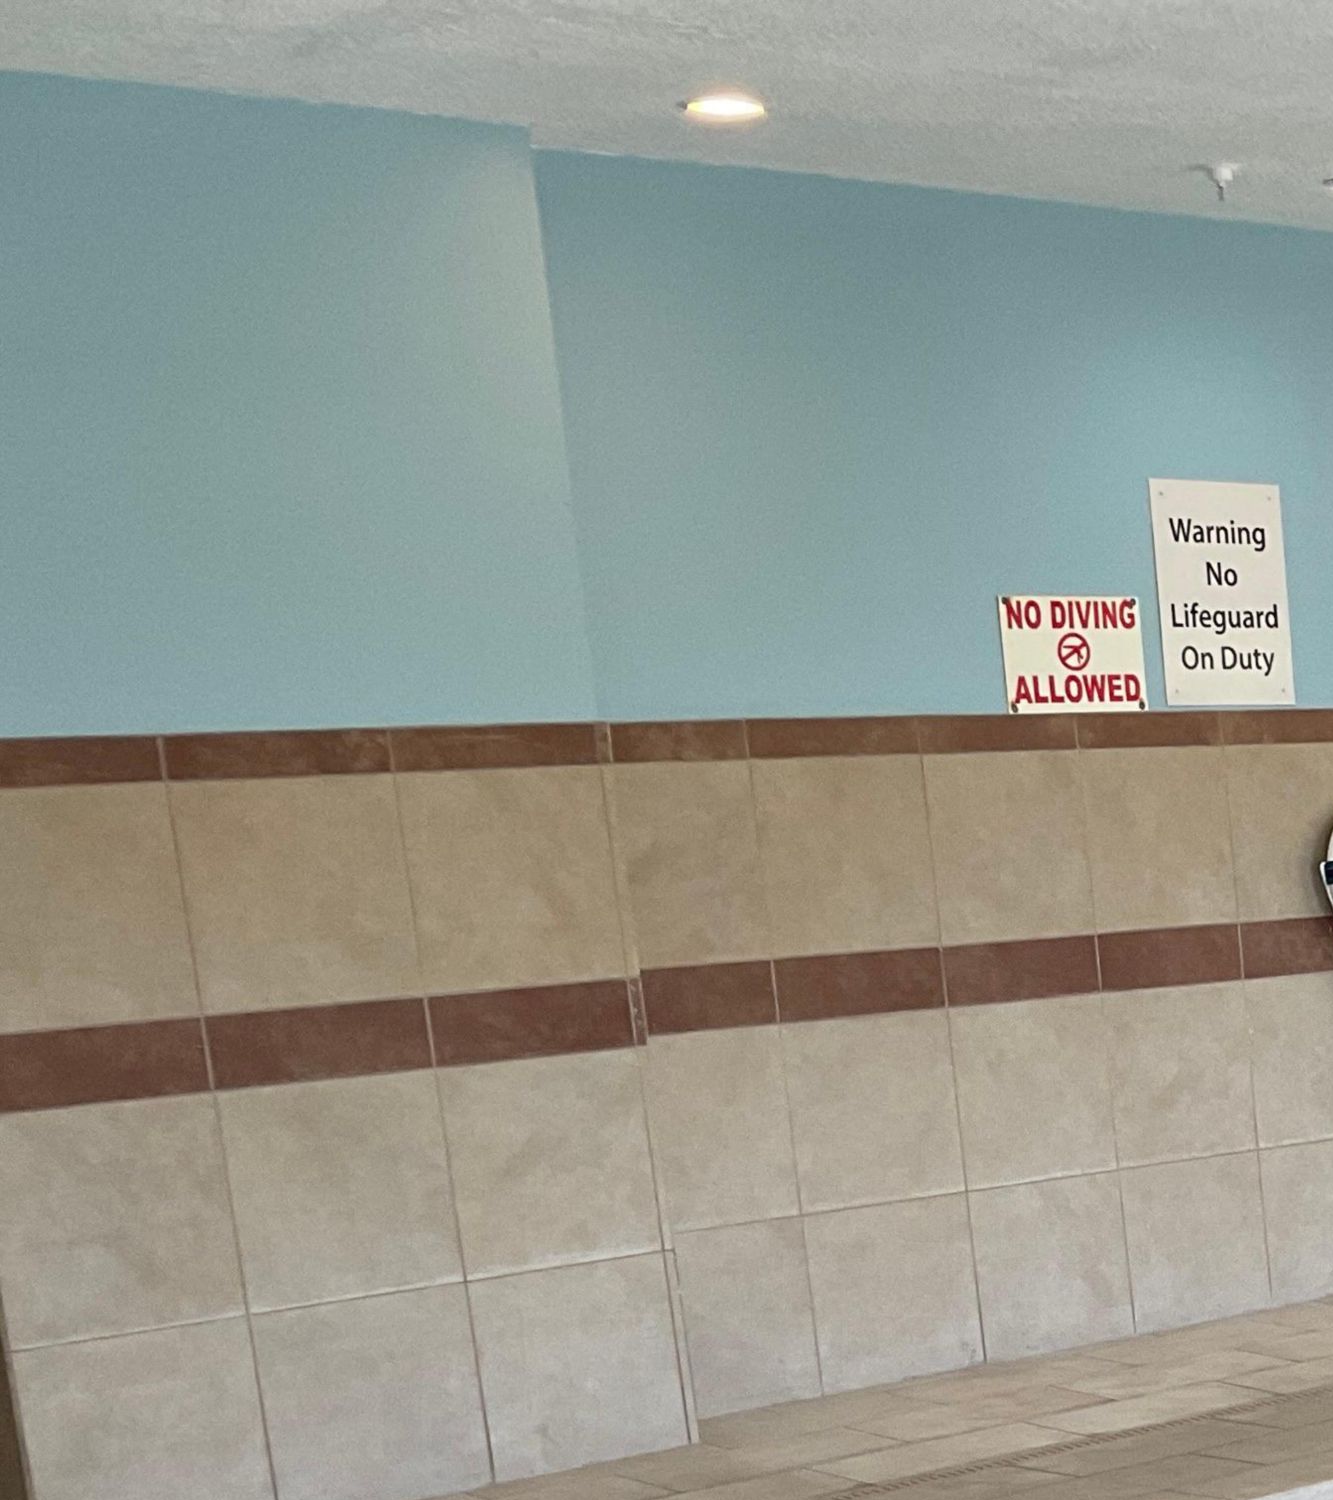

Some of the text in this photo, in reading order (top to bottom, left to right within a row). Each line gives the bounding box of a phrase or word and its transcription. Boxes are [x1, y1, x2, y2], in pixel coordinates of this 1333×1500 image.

[1169, 517, 1266, 552] Warning
[1205, 561, 1238, 586] No
[1004, 600, 1136, 629] NO DIVING
[1171, 602, 1279, 635] Lifeguard
[1181, 645, 1275, 676] On Duty
[1015, 674, 1142, 703] ALLOWED
